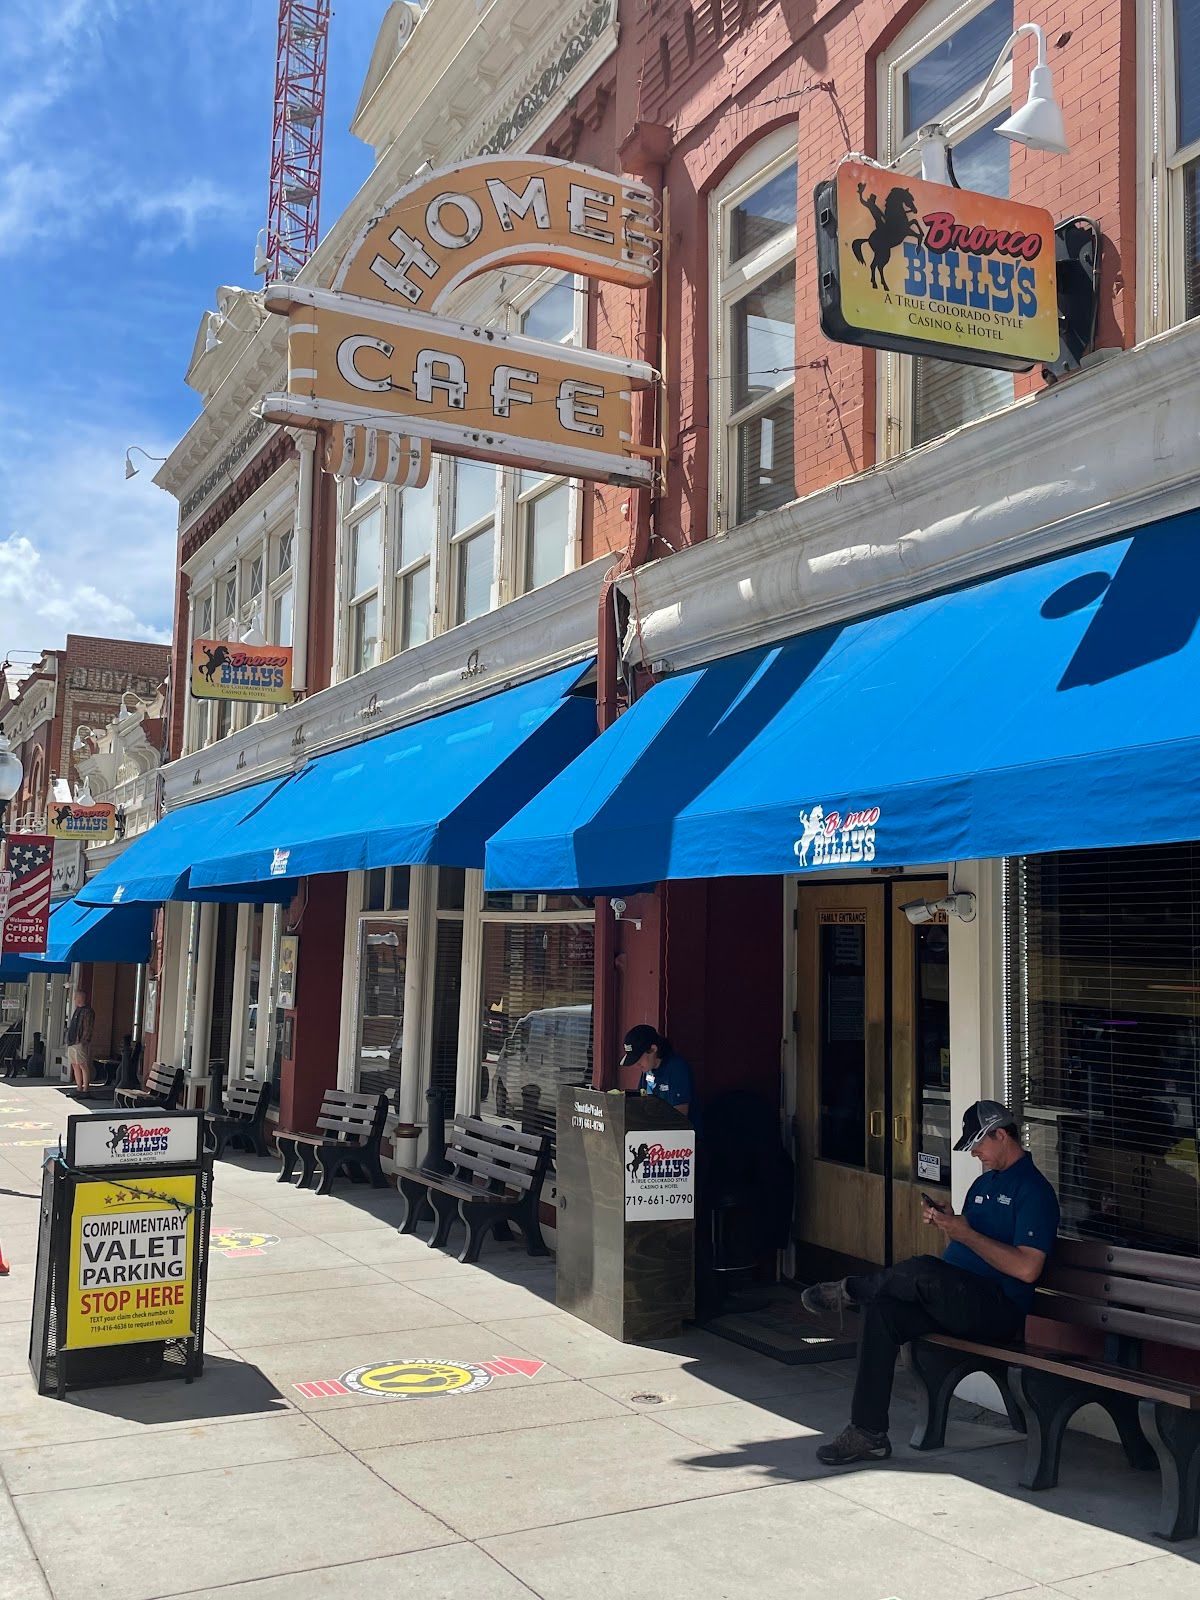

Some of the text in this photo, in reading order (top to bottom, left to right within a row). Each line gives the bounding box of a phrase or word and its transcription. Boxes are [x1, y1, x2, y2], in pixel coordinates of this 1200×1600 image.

[368, 176, 615, 304] HOME
[922, 211, 1043, 261] Bronco
[903, 241, 1038, 319] BILLY'S
[884, 293, 893, 305] A
[955, 323, 964, 334] &
[336, 333, 605, 437] CAFE
[231, 652, 288, 667] Bronco
[820, 912, 866, 923] FAMILY ENTRANCE
[6, 923, 45, 933] Cripple
[5, 933, 43, 944] Creek
[128, 1124, 171, 1143] Bronco
[648, 1143, 693, 1166] Bronco
[920, 1155, 937, 1164] NOTICE
[626, 1194, 693, 1206] 719-661-0790
[82, 1215, 187, 1238] COMPLIMENTARY
[83, 1235, 185, 1263] VALET
[83, 1260, 183, 1286] PARKING
[80, 1285, 185, 1315] STOP HERE
[104, 1315, 116, 1323] your
[117, 1312, 131, 1320] claim
[132, 1310, 147, 1319] check
[147, 1308, 168, 1317] number
[134, 1319, 154, 1329] request
[155, 1317, 174, 1326] vehicle
